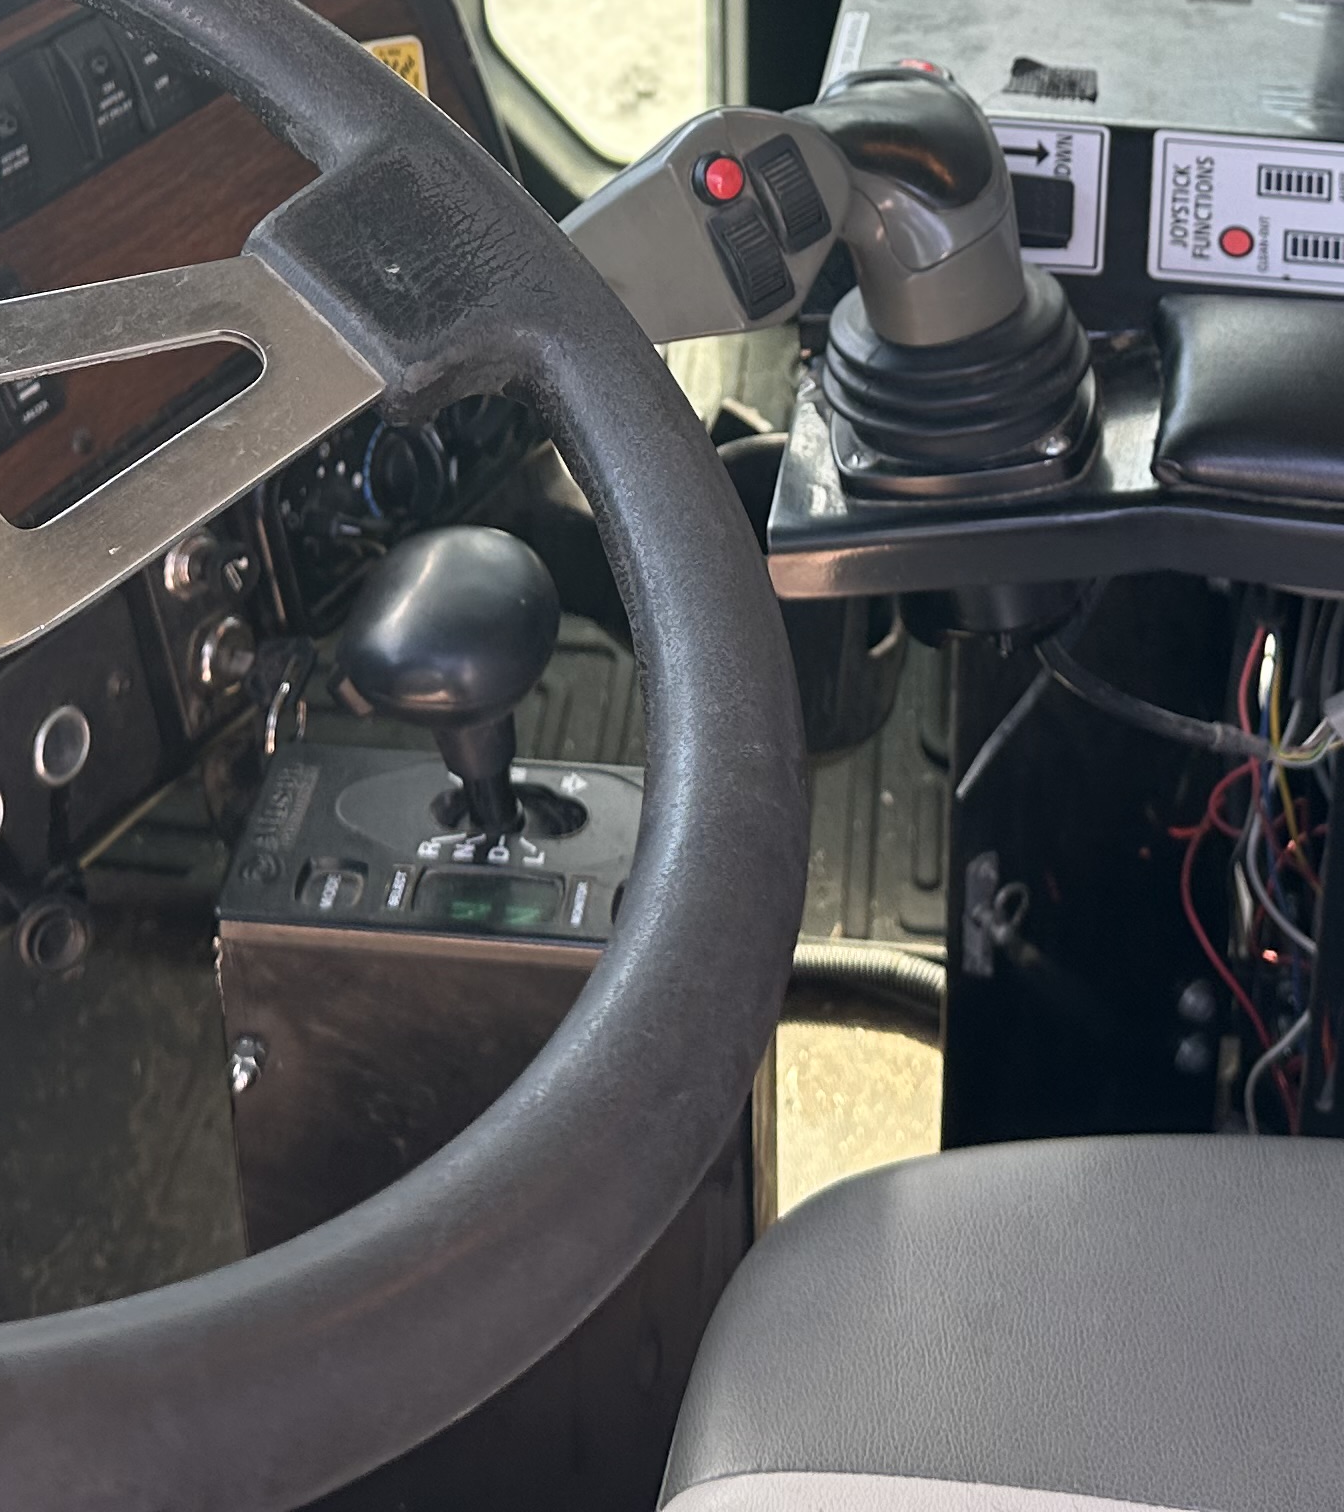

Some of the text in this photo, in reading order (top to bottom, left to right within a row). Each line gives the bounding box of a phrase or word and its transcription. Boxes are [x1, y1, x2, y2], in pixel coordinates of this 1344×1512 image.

[1054, 134, 1073, 176] OWN
[1170, 163, 1192, 248] JOYSTICK
[1192, 156, 1214, 259] FUNCTIONS
[418, 840, 440, 860] R
[488, 844, 509, 864] D
[523, 851, 545, 866] L
